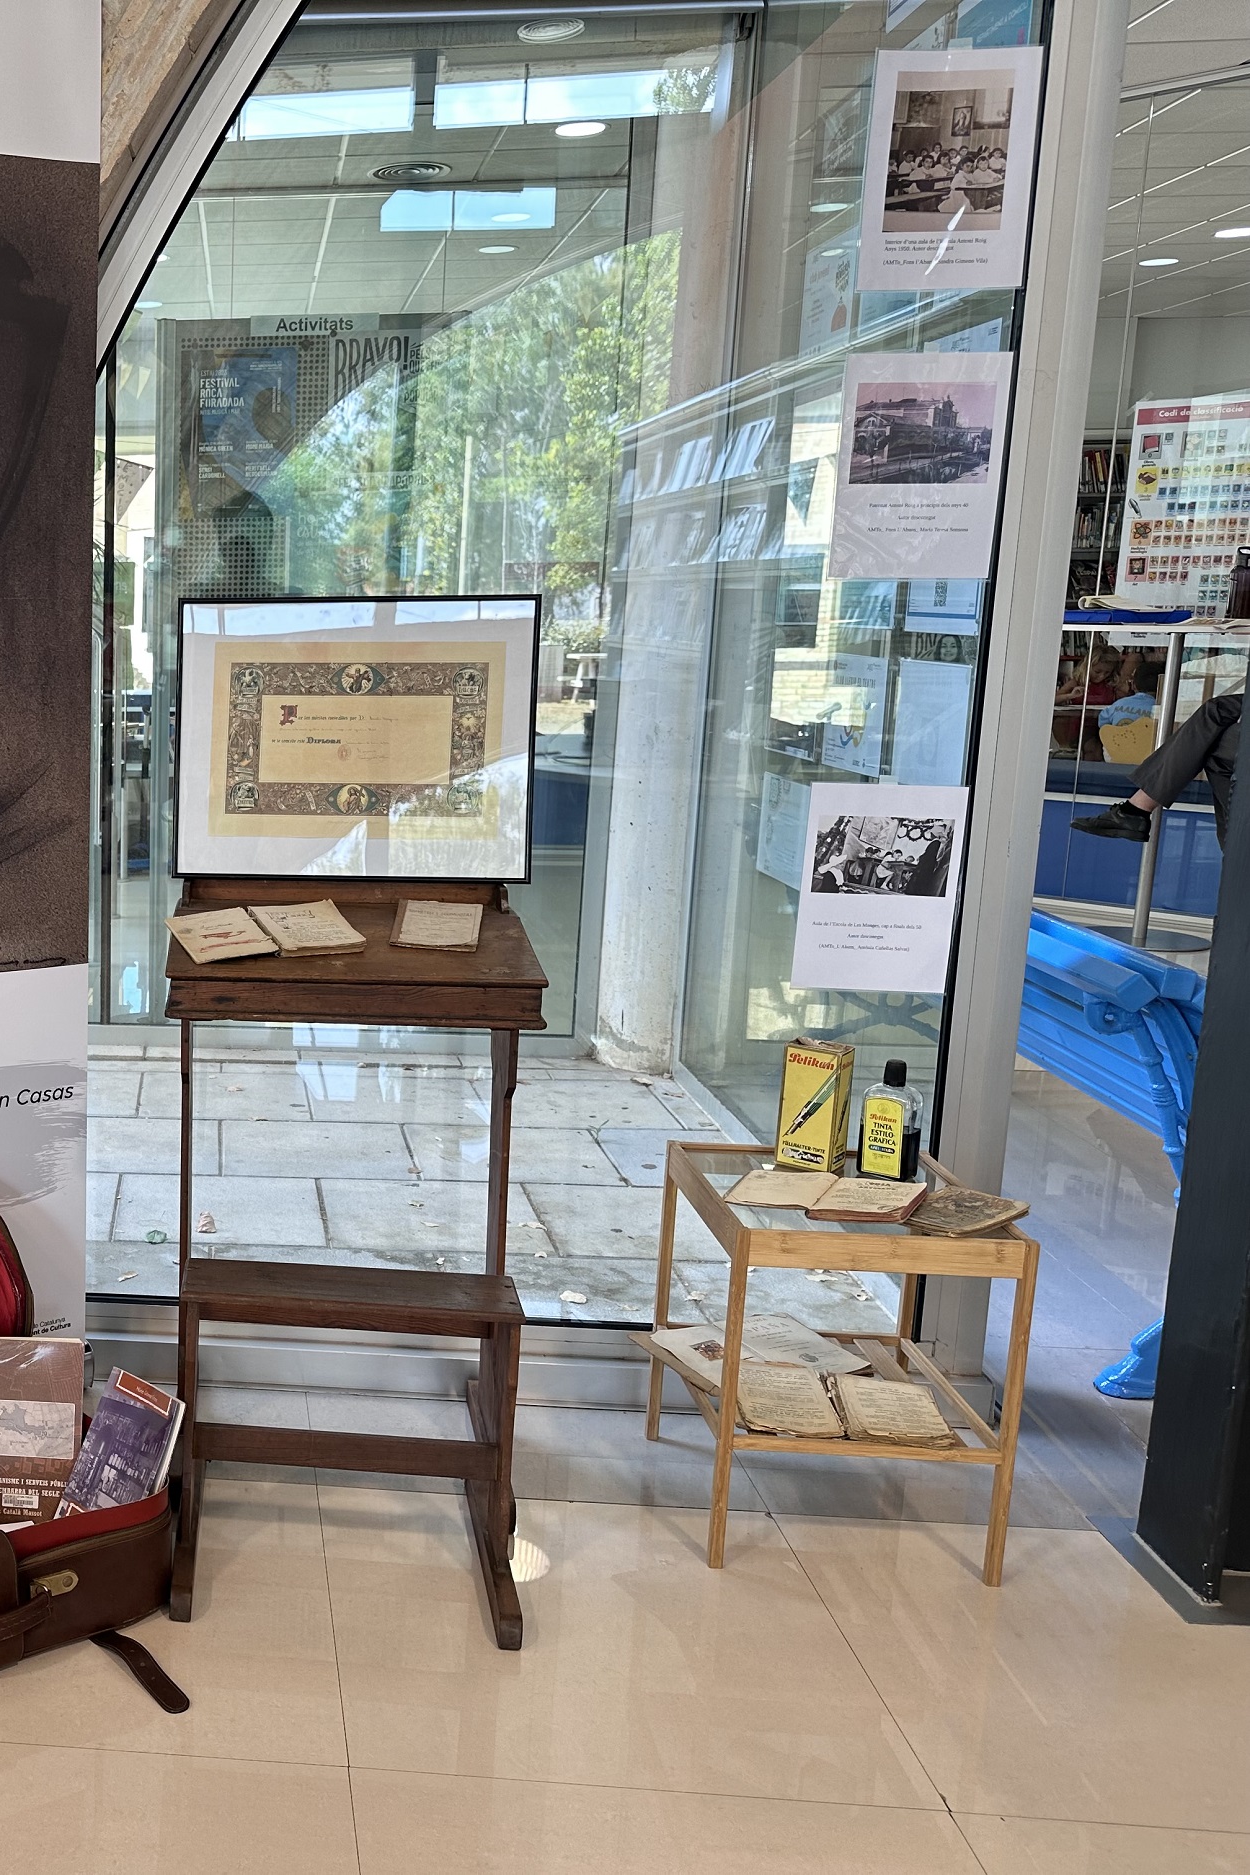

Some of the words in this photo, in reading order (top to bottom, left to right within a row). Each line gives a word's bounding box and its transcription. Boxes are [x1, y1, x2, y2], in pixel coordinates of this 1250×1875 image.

[275, 317, 354, 332] Activitats
[1159, 409, 1178, 417] Codi
[1193, 406, 1244, 415] classificació
[788, 1052, 835, 1070] Pelikan
[16, 1082, 75, 1106] Casas
[873, 1122, 893, 1131] TINTA
[871, 1129, 895, 1138] ESTILO-
[39, 1317, 66, 1327] Catalunya
[50, 1322, 71, 1332] Cultura
[23, 1509, 42, 1517] Massot
